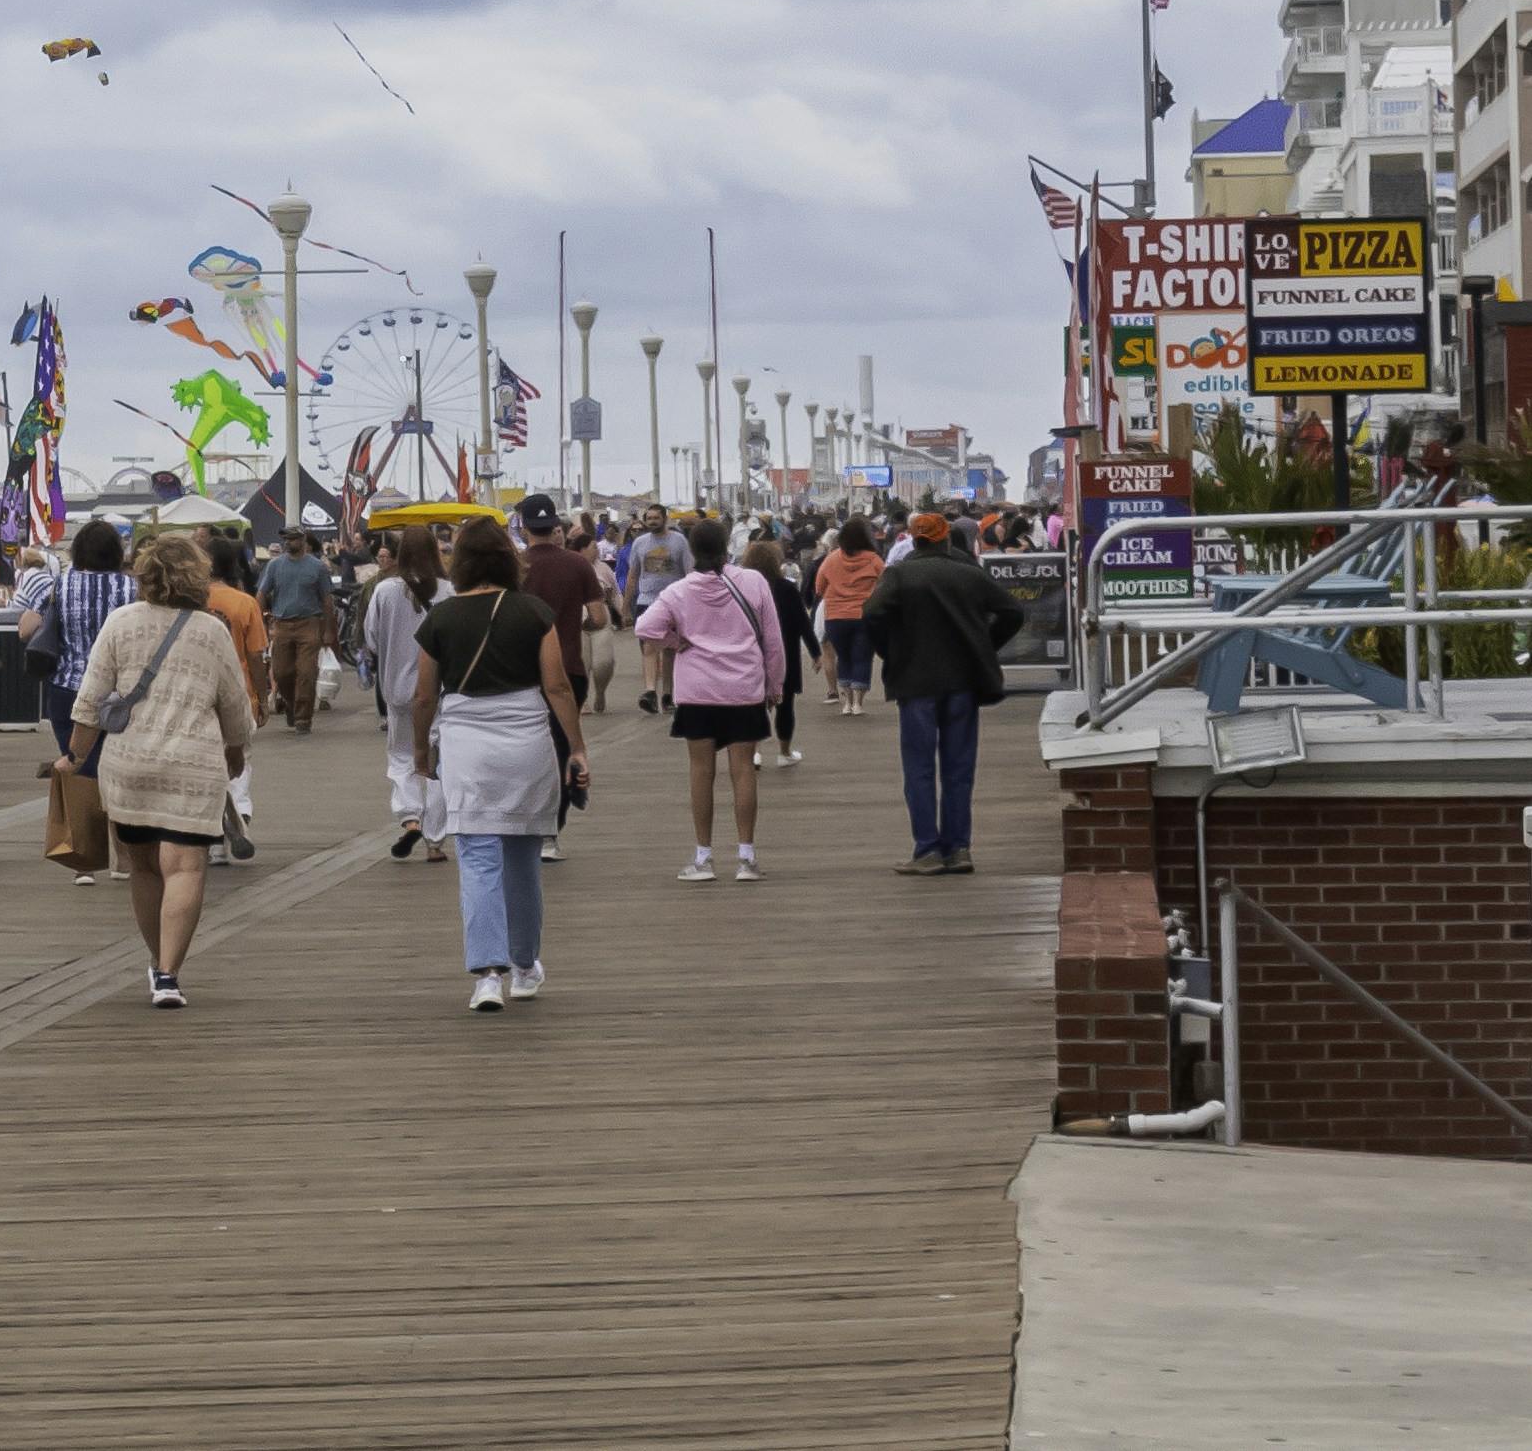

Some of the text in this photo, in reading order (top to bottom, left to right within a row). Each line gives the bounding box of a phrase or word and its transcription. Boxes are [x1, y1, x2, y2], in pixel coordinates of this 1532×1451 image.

[1304, 230, 1417, 270] PIZZA
[1257, 287, 1416, 305] FUNNEL CAKE
[1260, 326, 1417, 346] FRIED OREOS
[1265, 364, 1413, 383] LEMONADE
[1094, 464, 1174, 480] FUNNEL
[1108, 479, 1162, 493] CAKE
[1108, 501, 1164, 514] FRIED
[1121, 537, 1154, 551] ICE
[1103, 550, 1173, 565] CREAM
